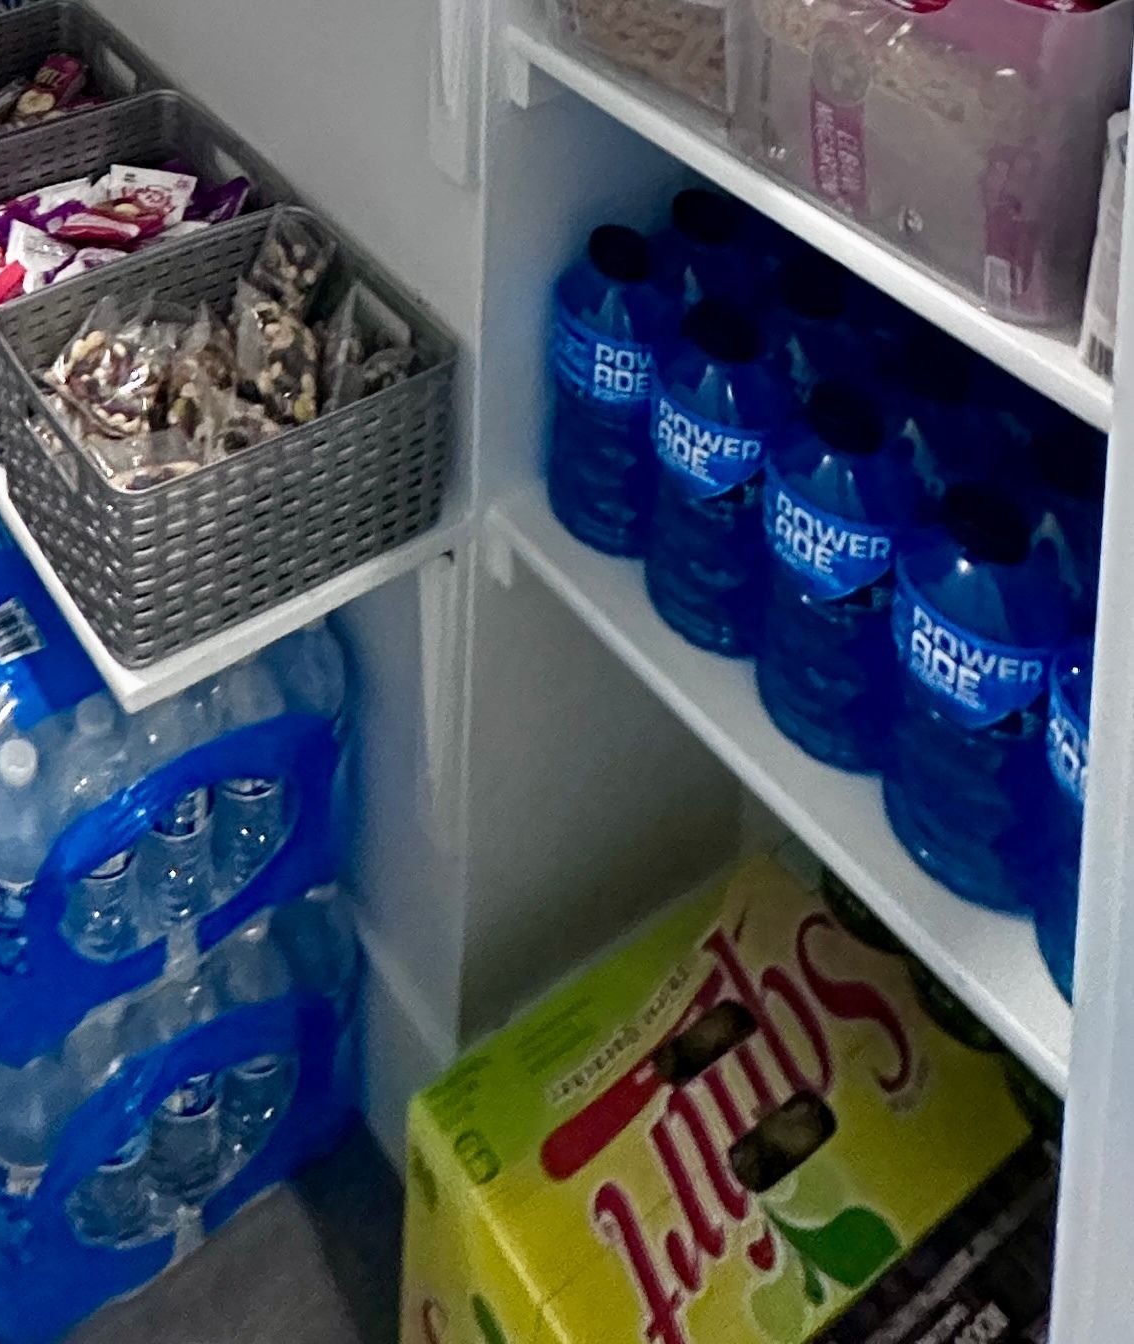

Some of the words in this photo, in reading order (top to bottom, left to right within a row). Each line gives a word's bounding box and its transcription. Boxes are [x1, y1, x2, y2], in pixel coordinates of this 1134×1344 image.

[658, 396, 762, 460] POWER
[776, 489, 892, 561] POWER
[912, 604, 1044, 684] POWER
